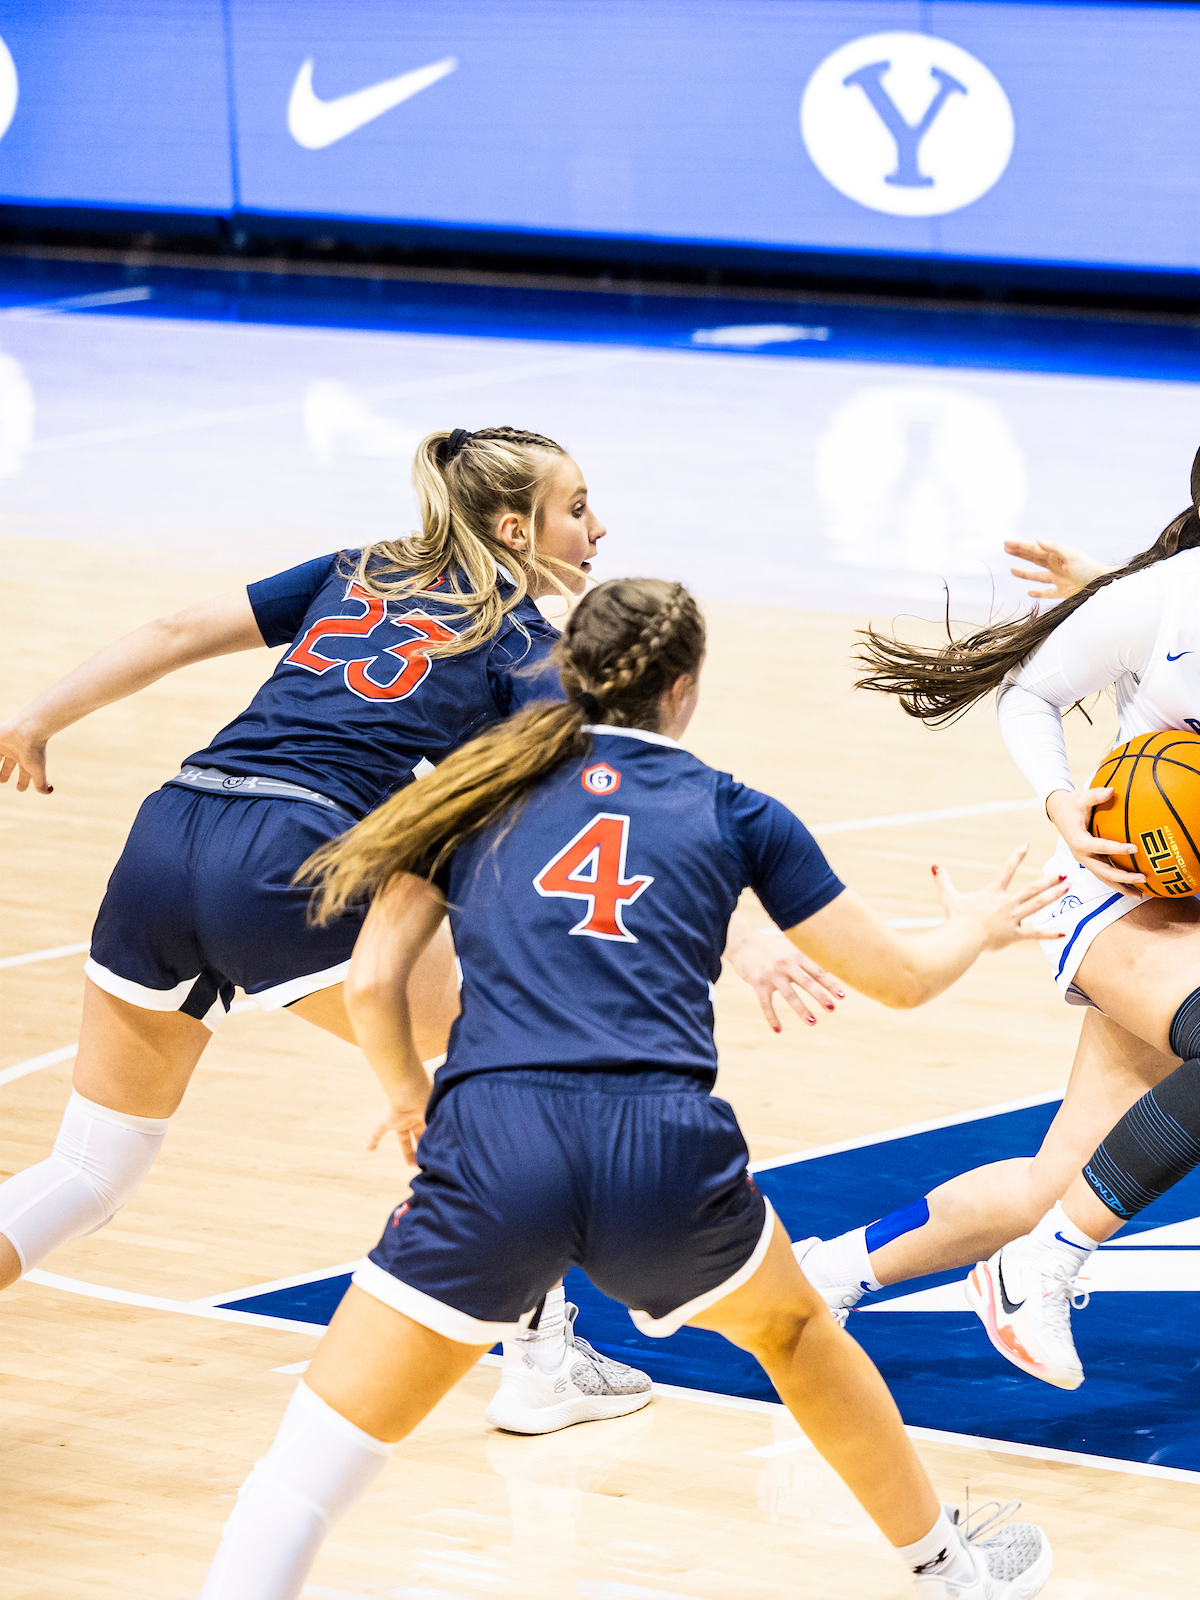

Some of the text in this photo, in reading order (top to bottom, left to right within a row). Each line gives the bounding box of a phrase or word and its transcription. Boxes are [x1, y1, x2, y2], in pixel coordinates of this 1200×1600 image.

[842, 59, 968, 190] Y
[283, 579, 462, 704] 23
[532, 812, 656, 945] 4
[1139, 827, 1194, 896] ELITE
